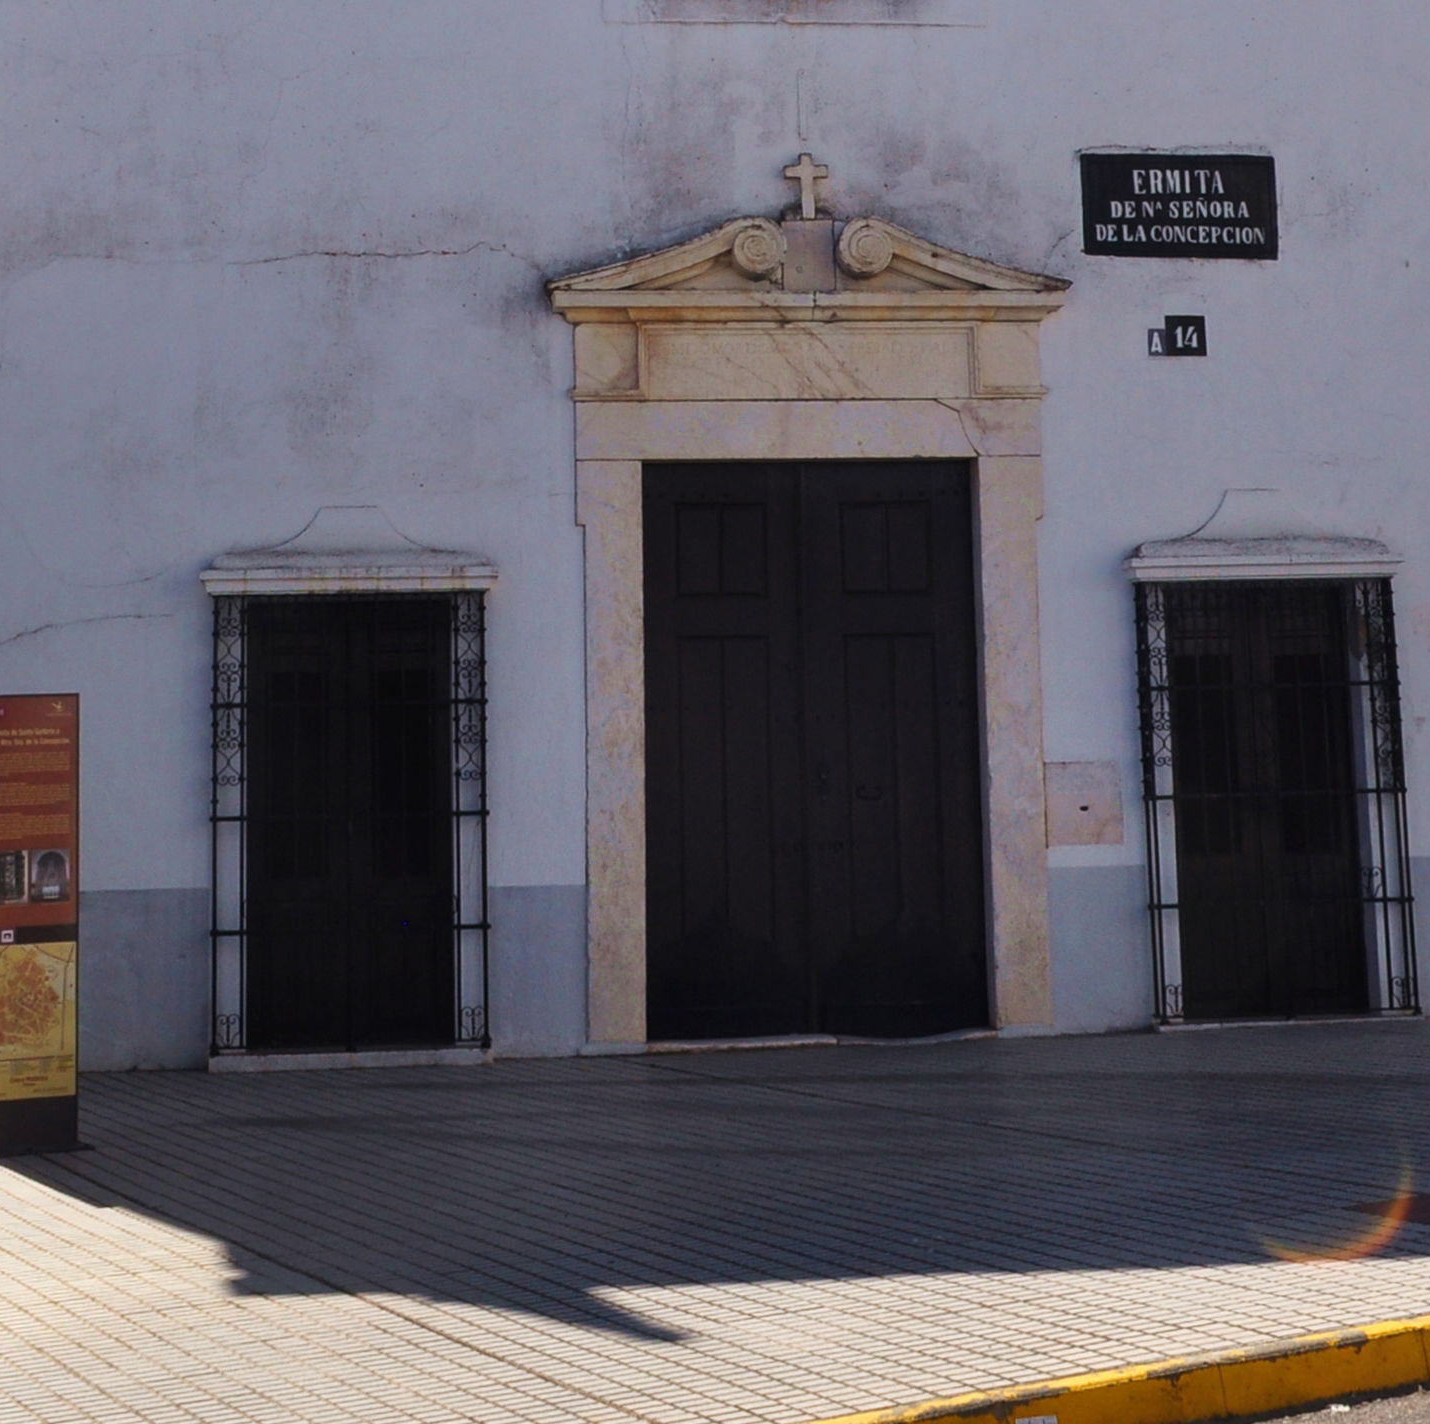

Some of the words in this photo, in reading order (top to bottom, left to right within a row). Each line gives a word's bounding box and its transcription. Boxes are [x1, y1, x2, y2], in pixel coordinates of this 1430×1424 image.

[1132, 169, 1225, 195] ERMITA
[1110, 201, 1136, 218] DE
[1169, 197, 1250, 219] SEÑORA
[1095, 224, 1118, 241] DE
[1122, 224, 1147, 242] LA
[1150, 225, 1266, 245] CONCEPCION
[1151, 331, 1163, 353] A
[1174, 326, 1198, 348] 14
